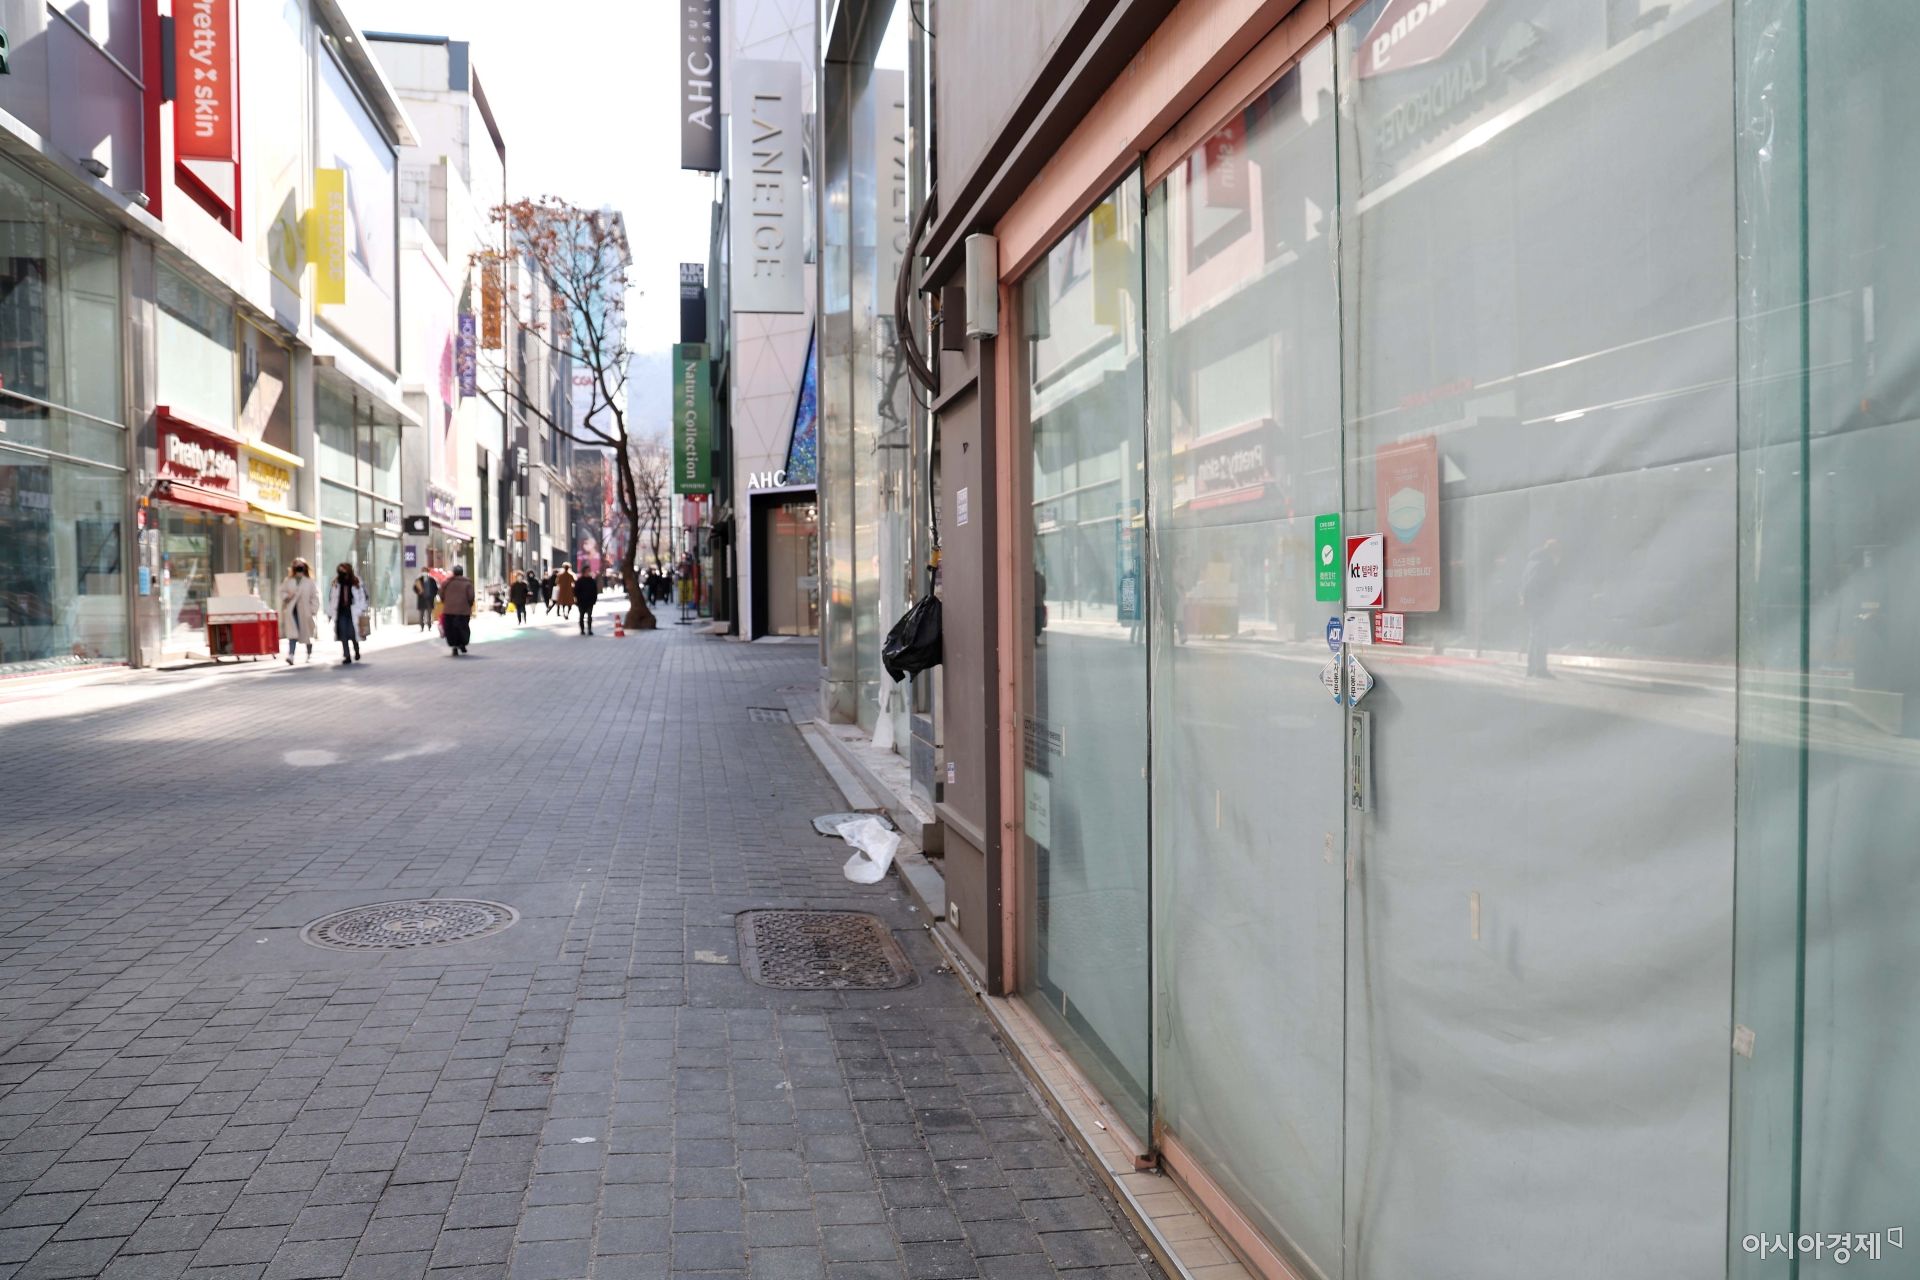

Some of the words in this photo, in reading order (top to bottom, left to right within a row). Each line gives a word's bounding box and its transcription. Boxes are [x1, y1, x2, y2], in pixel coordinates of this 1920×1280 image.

[189, 0, 216, 66] retty
[702, 0, 712, 43] SAL
[194, 85, 219, 137] skin
[687, 51, 713, 131] AHC
[752, 95, 785, 279] LANEIGE
[680, 263, 704, 274] ABC
[685, 361, 697, 408] Nature
[166, 433, 206, 477] Pretty
[215, 452, 237, 479] skin
[685, 410, 699, 479] Collection
[748, 469, 786, 489] AHC
[1351, 563, 1360, 578] kt
[1329, 628, 1340, 640] ADT
